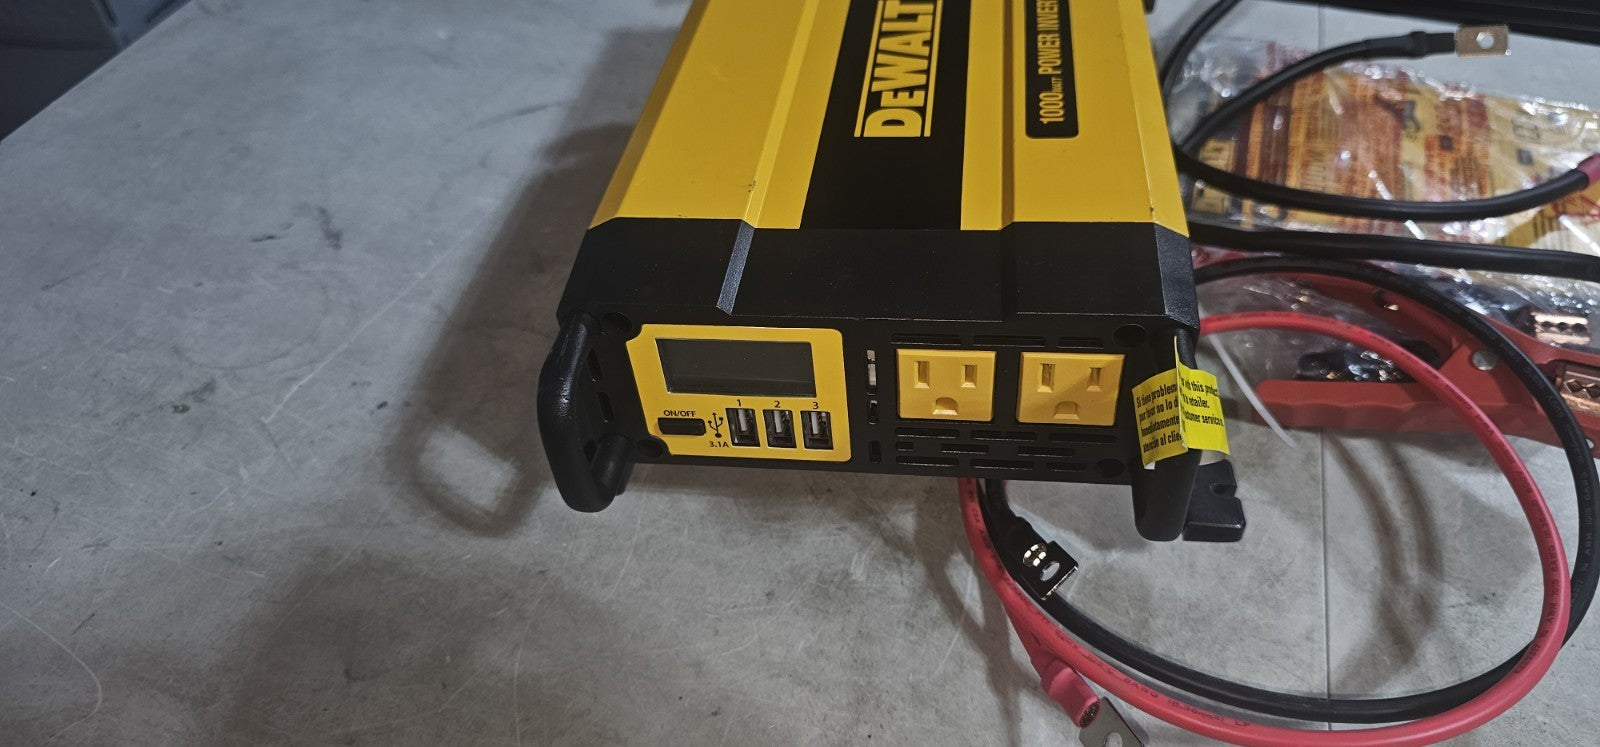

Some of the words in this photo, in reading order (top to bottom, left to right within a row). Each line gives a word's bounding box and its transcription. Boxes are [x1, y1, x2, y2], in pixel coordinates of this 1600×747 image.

[1037, 33, 1061, 75] POWER
[863, 0, 934, 137] DEWALT
[1051, 77, 1063, 92] WATT
[1039, 92, 1064, 124] 1000
[1190, 380, 1205, 393] this
[737, 399, 742, 407] 1
[774, 401, 781, 409] 2
[813, 402, 819, 410] 3
[1136, 396, 1142, 408] Si
[1156, 403, 1165, 413] no
[1165, 398, 1173, 410] lo
[709, 440, 729, 448] 3.1A
[1160, 432, 1167, 446] al
